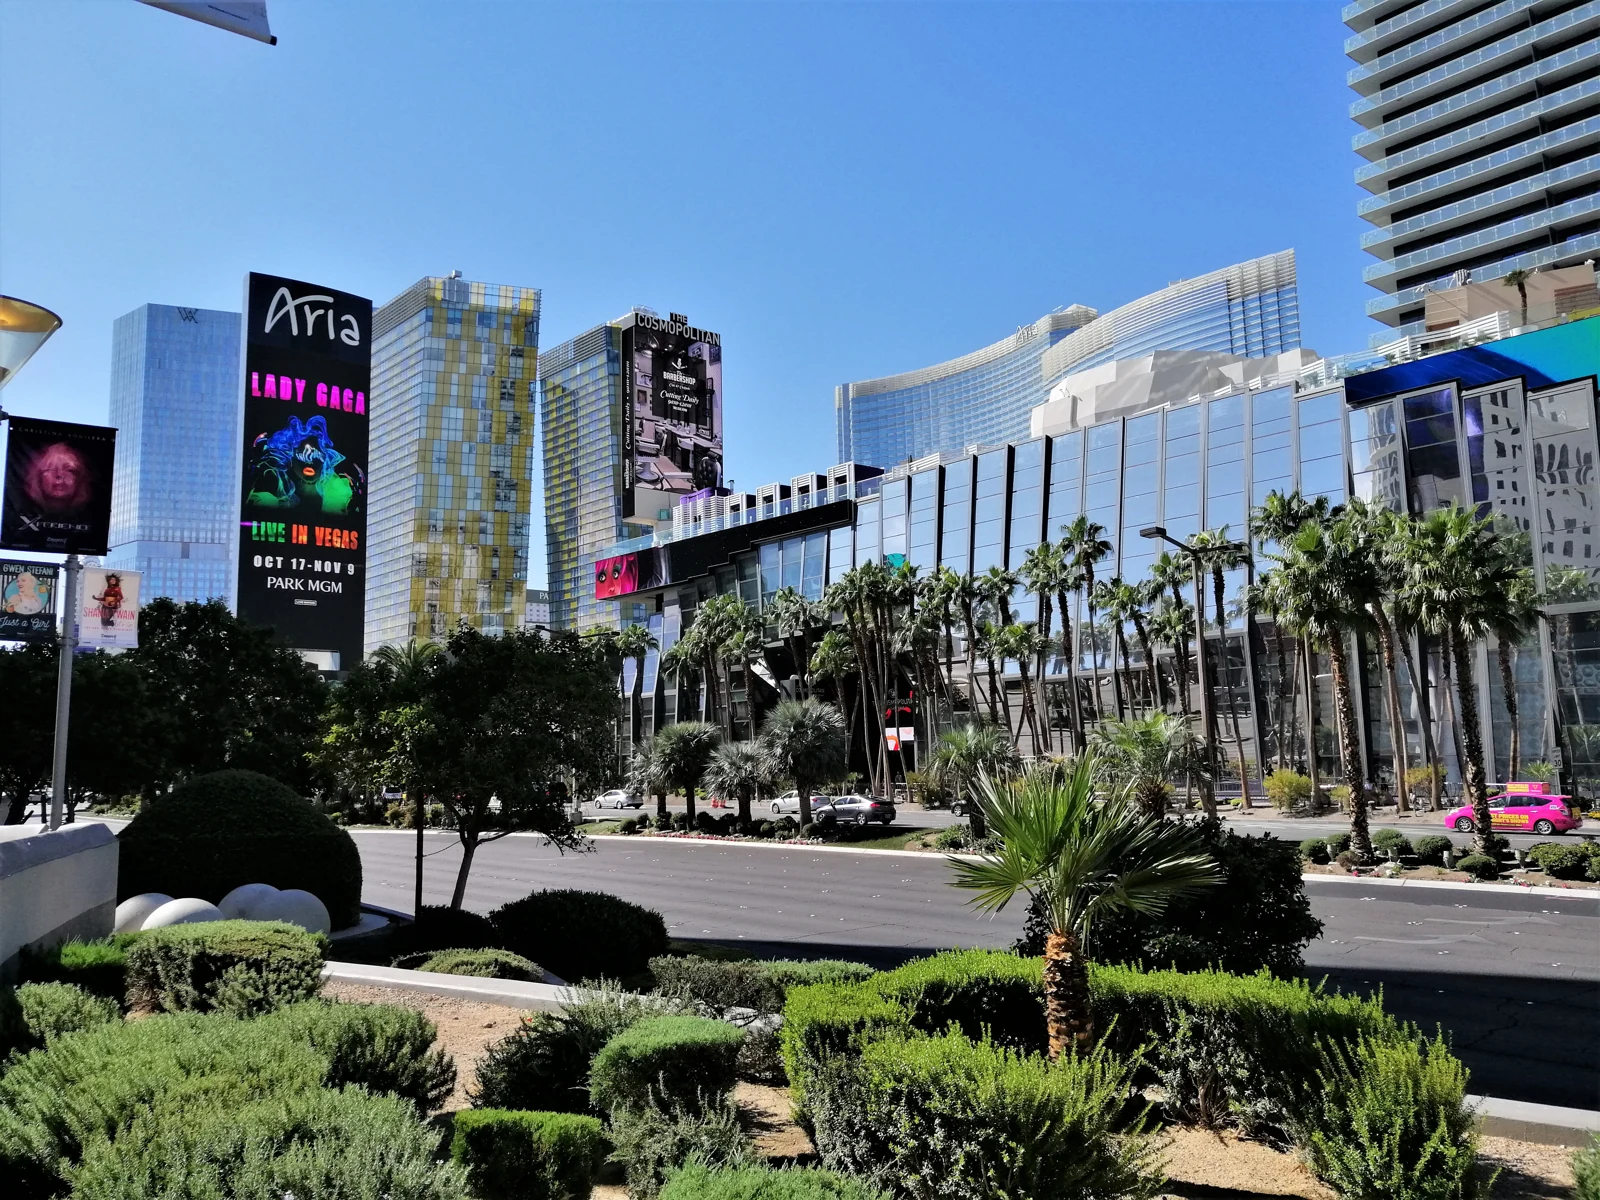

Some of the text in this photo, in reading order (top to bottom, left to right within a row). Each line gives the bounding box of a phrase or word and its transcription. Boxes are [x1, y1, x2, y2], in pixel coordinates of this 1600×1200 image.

[264, 286, 360, 346] Aria
[671, 312, 688, 324] THE
[637, 313, 720, 346] COSMOPOLITAN
[663, 371, 696, 385] BARBERSHOP
[251, 371, 366, 416] LADY GAGA
[252, 520, 359, 550] LIVE IN VEGAS
[3, 563, 54, 576] GWEN STEFANI
[253, 554, 284, 569] OCT
[347, 563, 355, 576] 9
[267, 576, 342, 594] PARK MGM
[0, 616, 20, 629] Just
[30, 617, 51, 631] Girl
